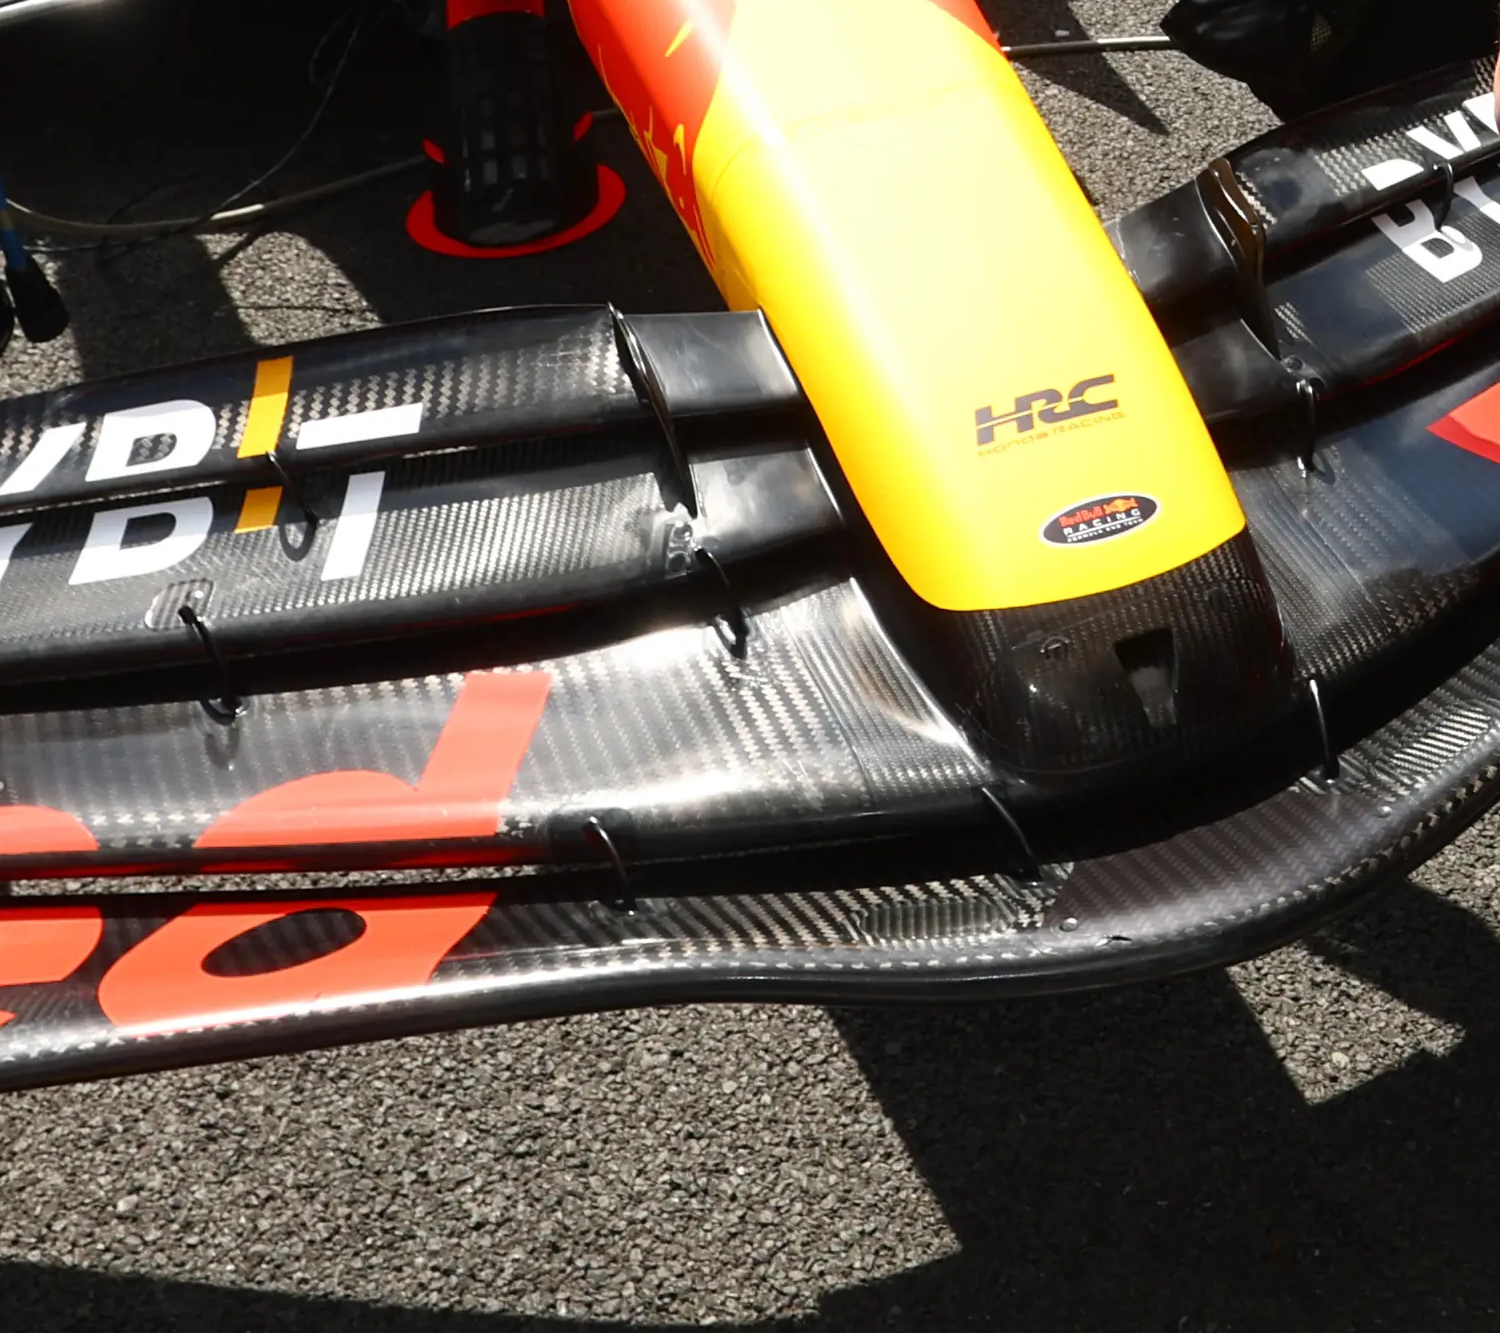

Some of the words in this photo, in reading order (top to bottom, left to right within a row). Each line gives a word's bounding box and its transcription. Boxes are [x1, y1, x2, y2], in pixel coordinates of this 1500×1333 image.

[975, 373, 1119, 447] HRC
[1052, 411, 1127, 435] RACING
[1063, 508, 1141, 536] RACING
